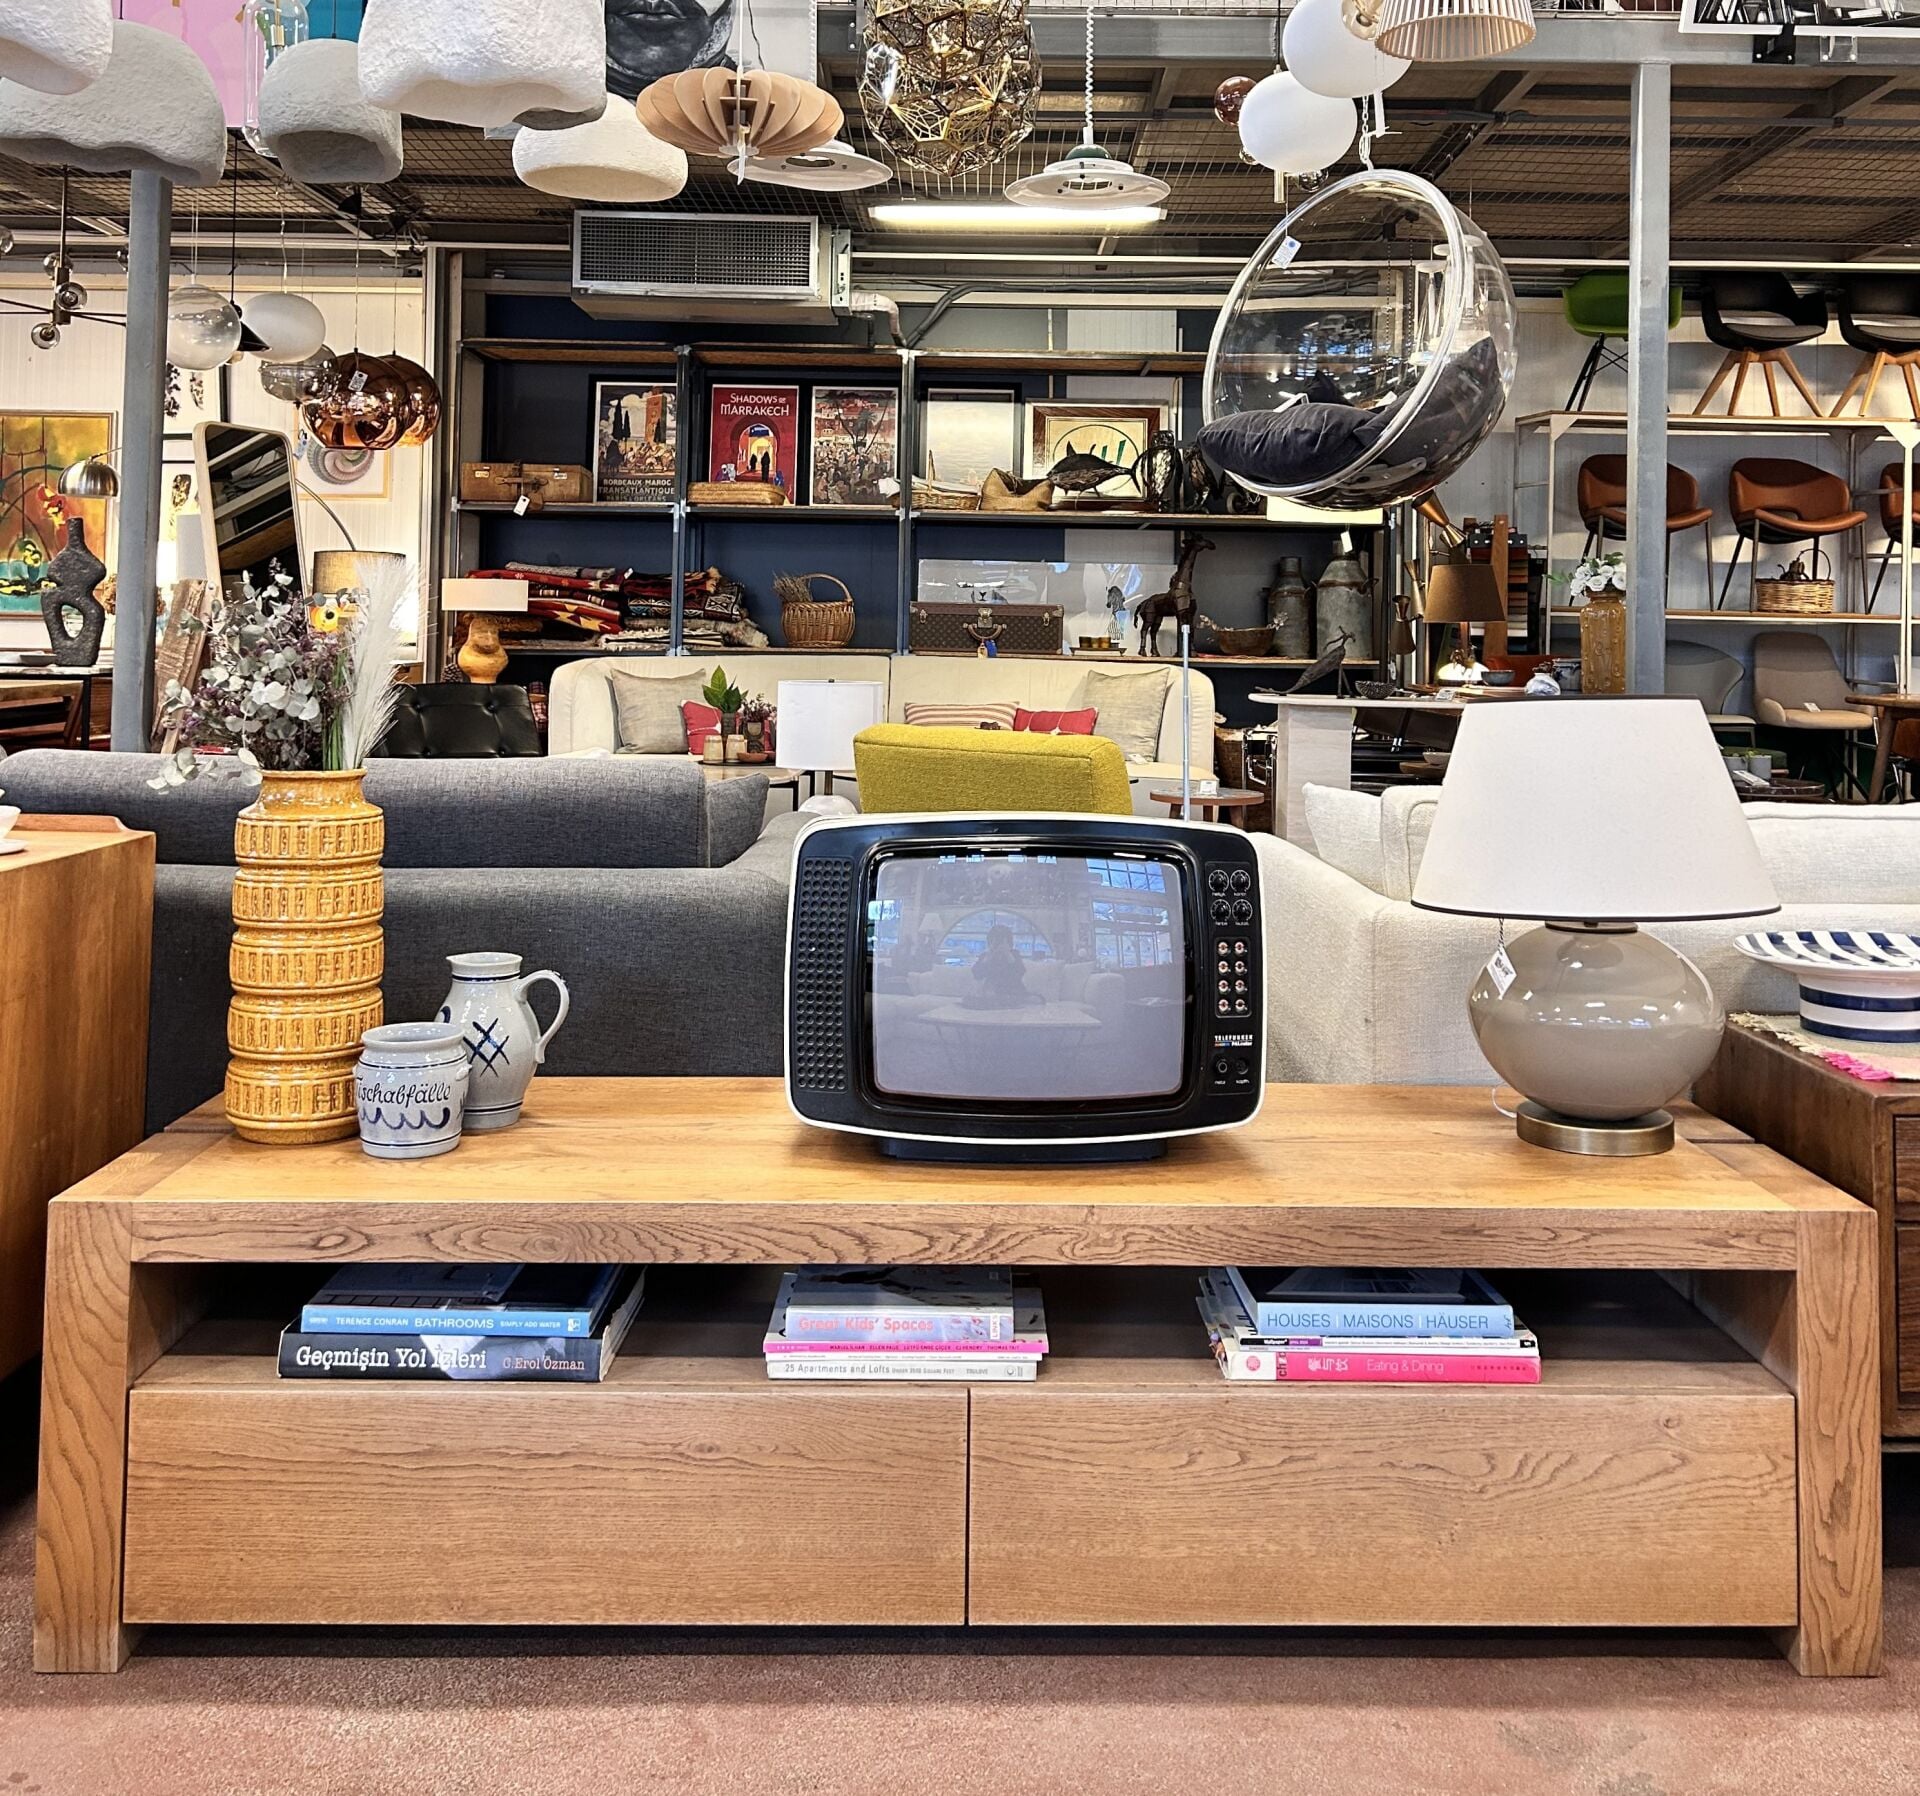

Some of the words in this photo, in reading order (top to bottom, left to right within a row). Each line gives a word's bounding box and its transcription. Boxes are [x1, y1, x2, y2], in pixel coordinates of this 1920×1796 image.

[730, 392, 778, 404] SHADOWS
[720, 403, 790, 416] MARRAKECH
[598, 486, 675, 495] TRANSATLANTIQUE
[335, 1316, 372, 1325] TERENCE
[373, 1317, 409, 1326] CONRAN
[414, 1317, 494, 1329] BATHROOMS
[799, 1315, 839, 1330] Great
[883, 1316, 934, 1333] Spaces
[1267, 1313, 1331, 1328] HOUSES
[1343, 1313, 1414, 1328] MAISONS
[1426, 1311, 1489, 1329] HÄUSER
[295, 1345, 390, 1371] Geçmişin
[395, 1347, 427, 1368] Yol
[431, 1344, 487, 1369] İzleri
[543, 1355, 585, 1370] Özman
[785, 1363, 795, 1373] 25
[798, 1363, 847, 1374] Apartments
[850, 1364, 866, 1373] and
[868, 1364, 890, 1373] Lofts
[1367, 1359, 1399, 1374] Eating
[1401, 1359, 1409, 1372] &
[1411, 1359, 1444, 1375] Dining
